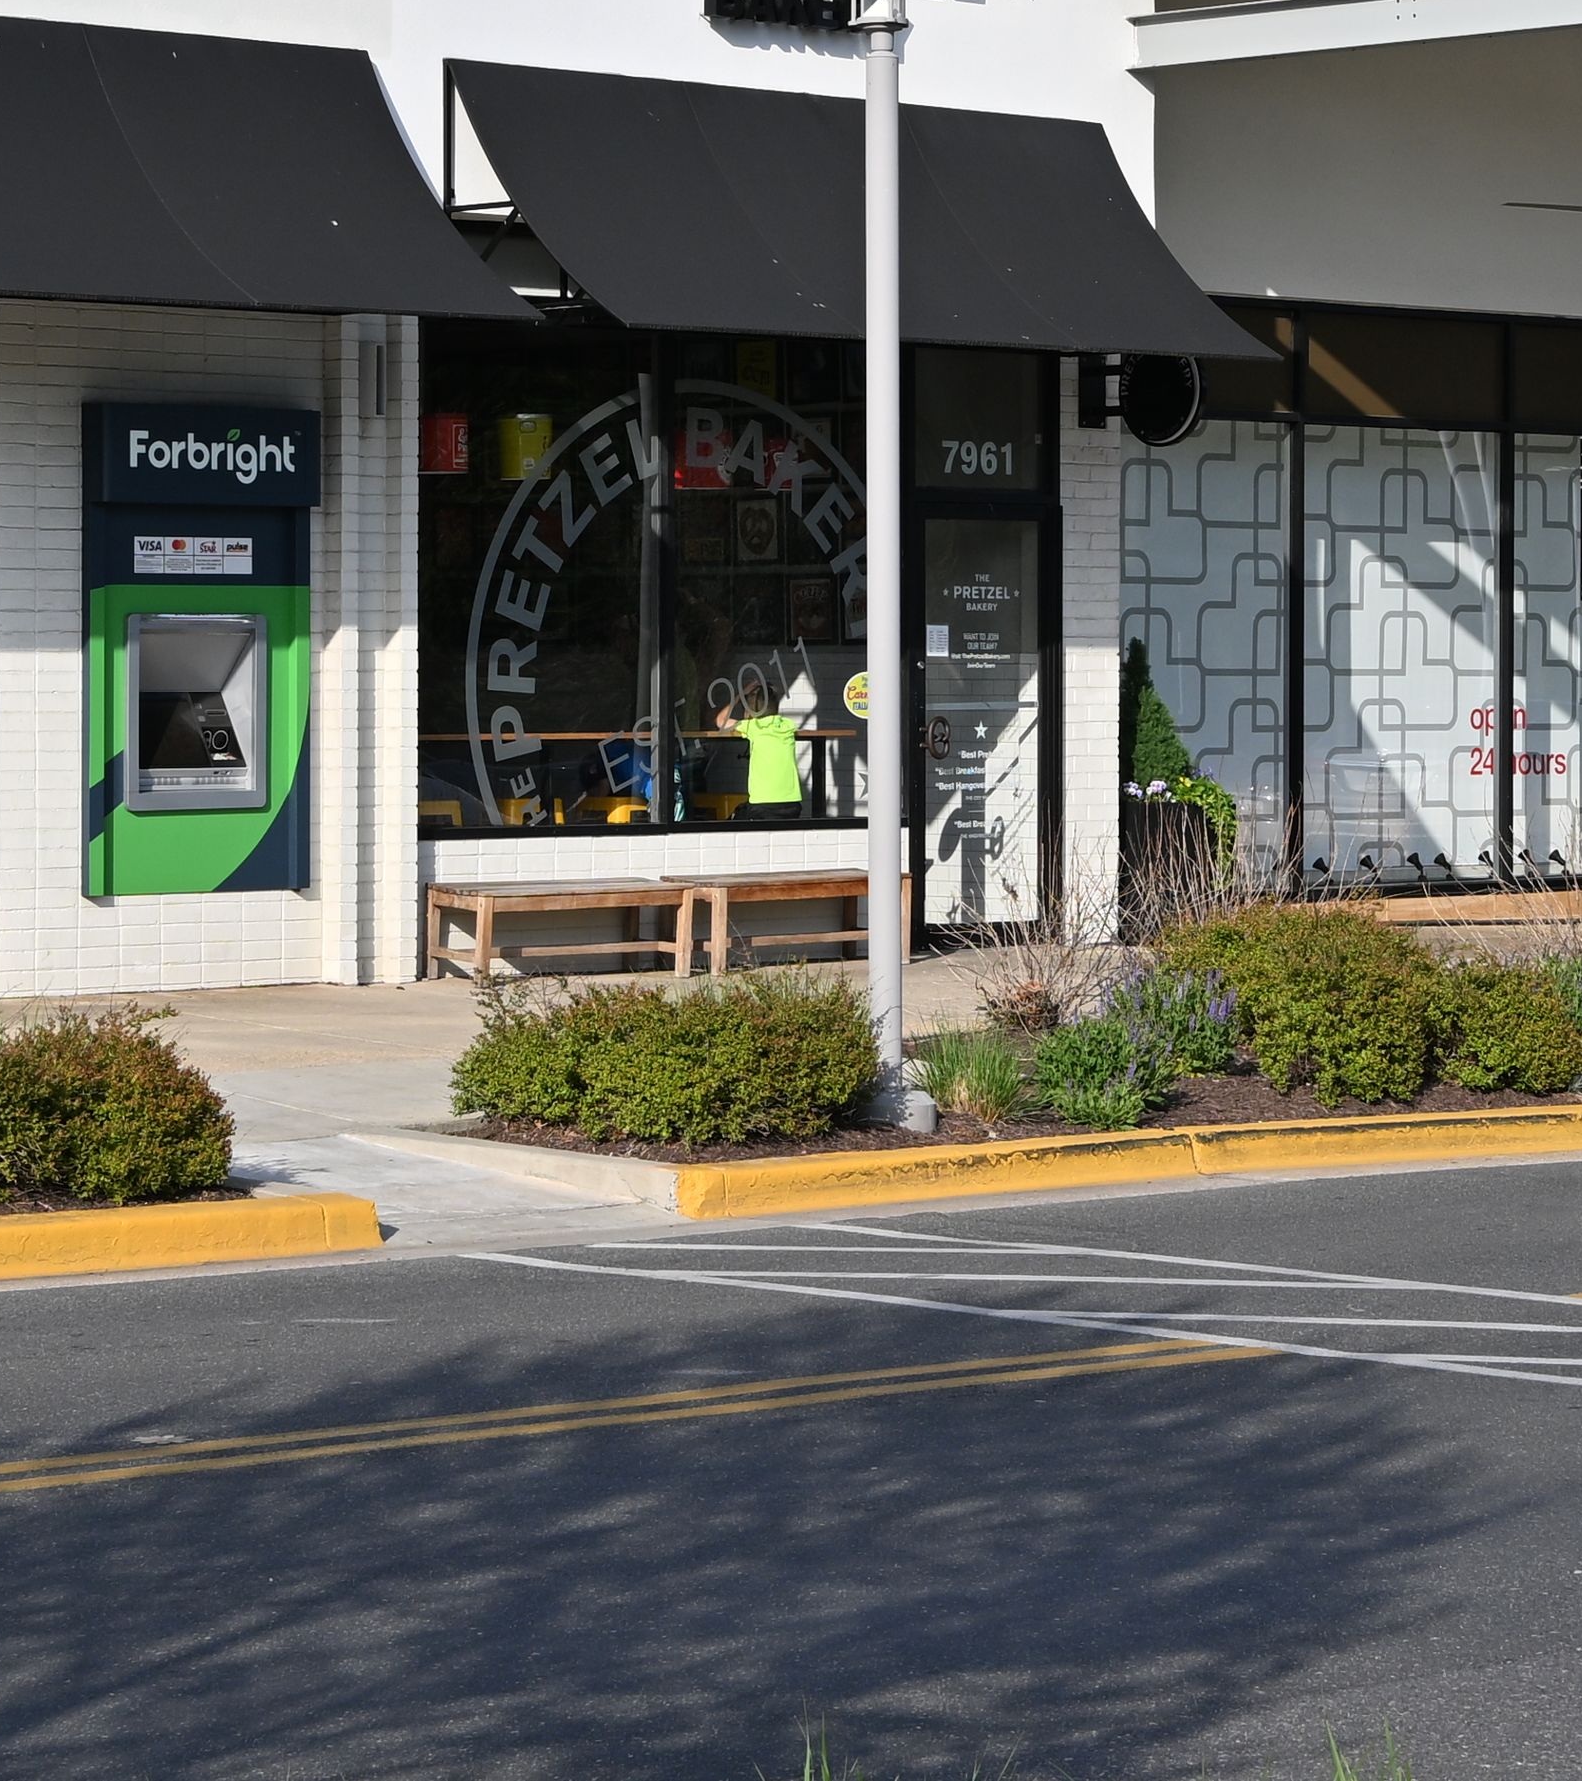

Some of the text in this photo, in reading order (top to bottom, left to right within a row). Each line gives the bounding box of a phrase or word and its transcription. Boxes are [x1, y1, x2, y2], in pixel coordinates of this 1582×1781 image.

[129, 428, 296, 485] Forbright
[941, 440, 1013, 476] 7961
[137, 540, 162, 551] VISA
[975, 574, 990, 582] THE
[953, 586, 1010, 600] PRETZEL
[966, 602, 998, 612] BAKERY
[707, 636, 816, 733] 2011
[1470, 707, 1526, 737] opn
